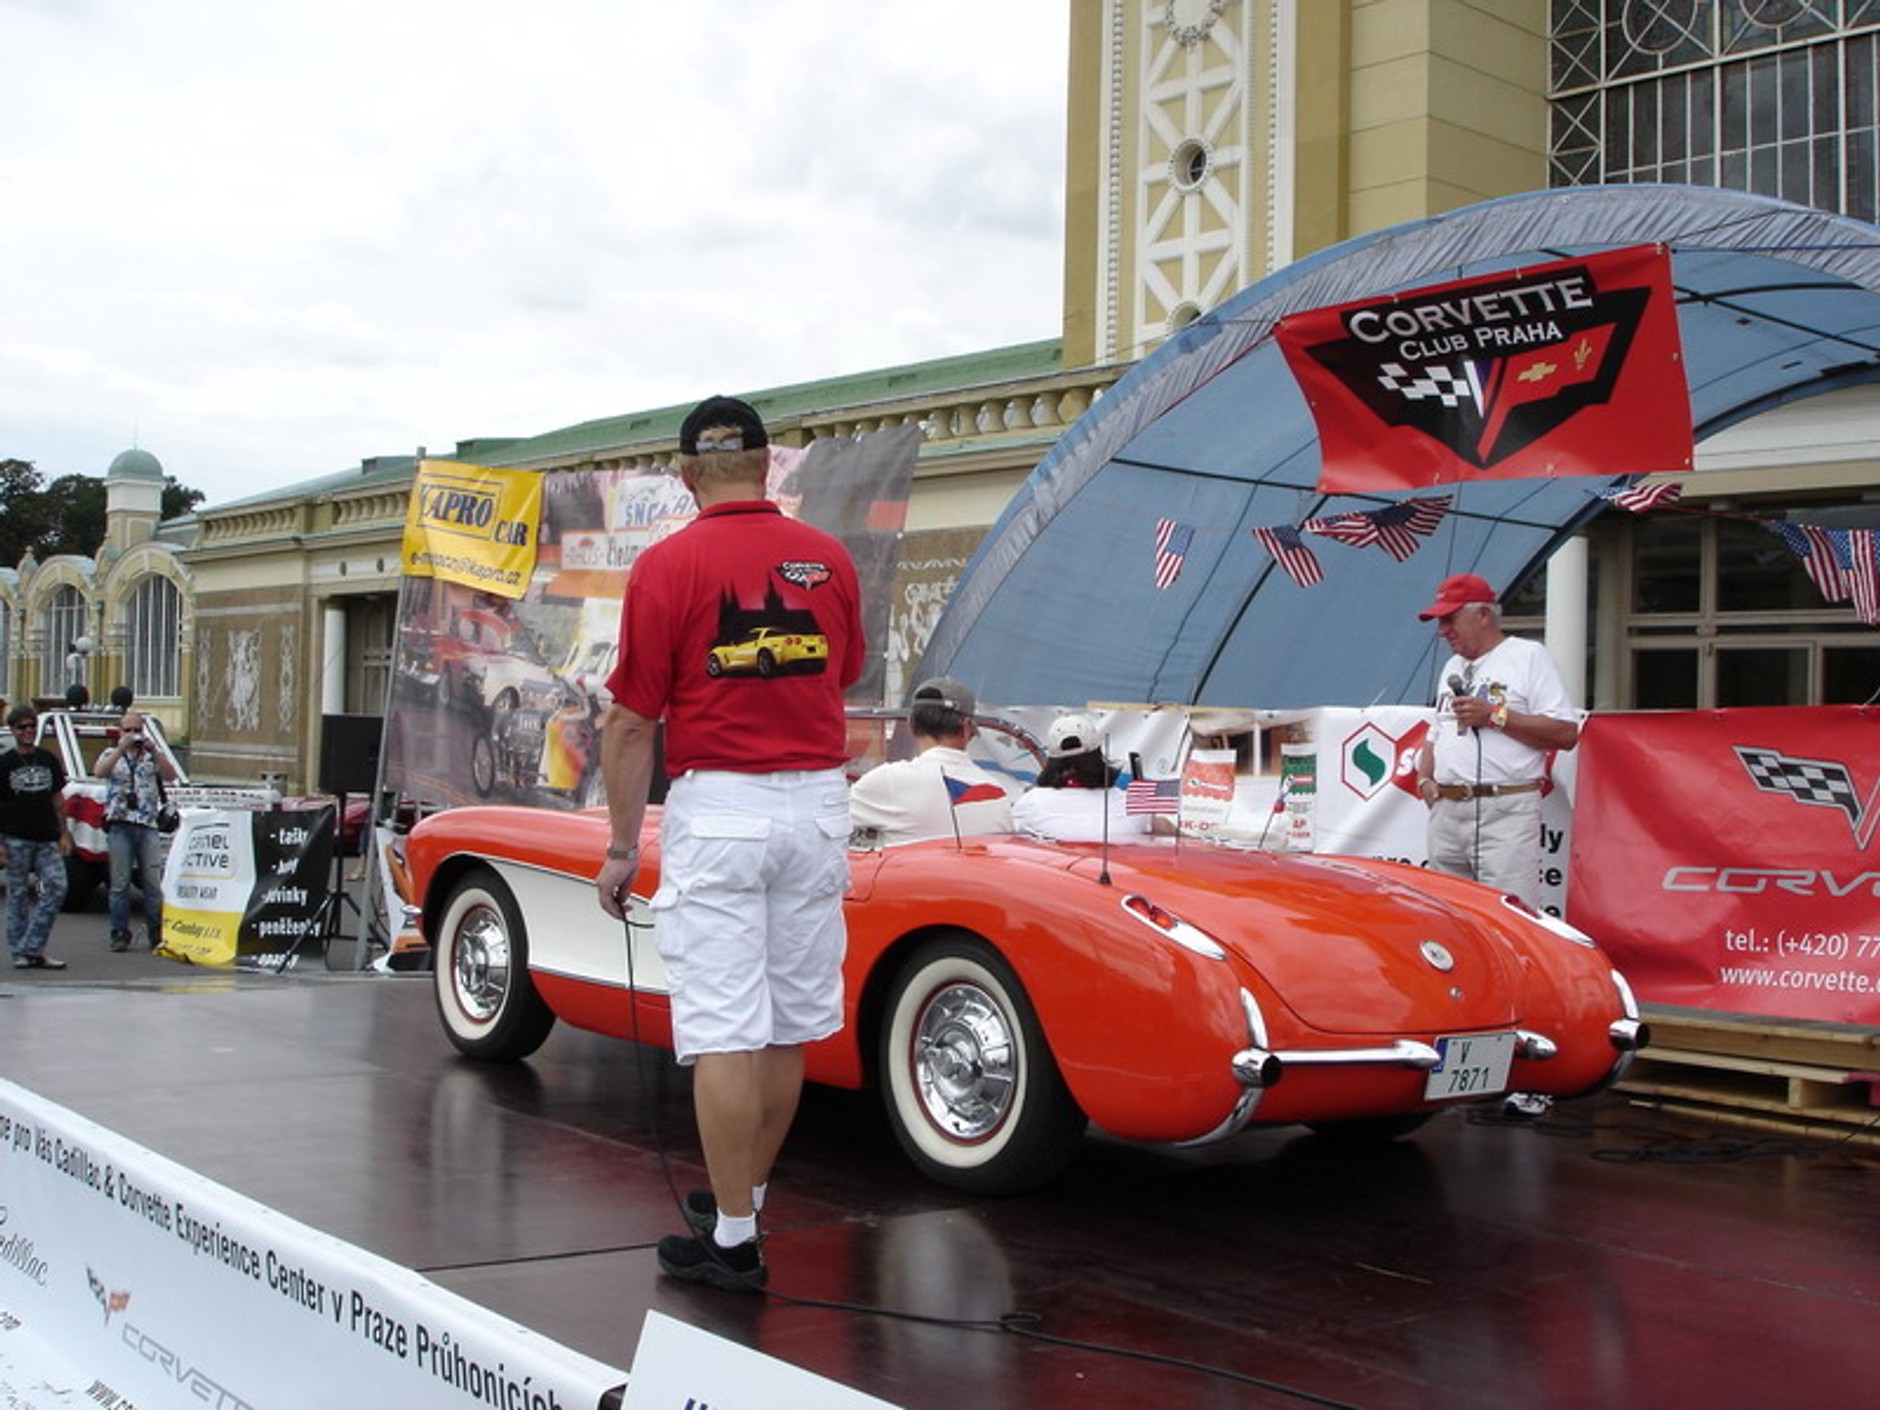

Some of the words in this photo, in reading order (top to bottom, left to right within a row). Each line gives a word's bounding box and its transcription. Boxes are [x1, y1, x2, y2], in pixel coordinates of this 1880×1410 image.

[1350, 279, 1593, 343] CORVETTE
[1399, 333, 1468, 362] CLUB
[1475, 319, 1563, 349] PRAHA
[494, 519, 528, 546] CAR
[1725, 928, 1769, 952] tel.:
[1777, 929, 1849, 960] (+420)
[1460, 1041, 1473, 1064] V
[1448, 1066, 1489, 1093] 7871
[14, 1123, 31, 1152] pro
[54, 1138, 101, 1191] Cadillac
[104, 1165, 114, 1199] &
[119, 1172, 171, 1232] Corvette
[175, 1203, 261, 1280] Experience
[265, 1250, 325, 1314] Center
[332, 1290, 342, 1323] v
[351, 1289, 408, 1358] Praze
